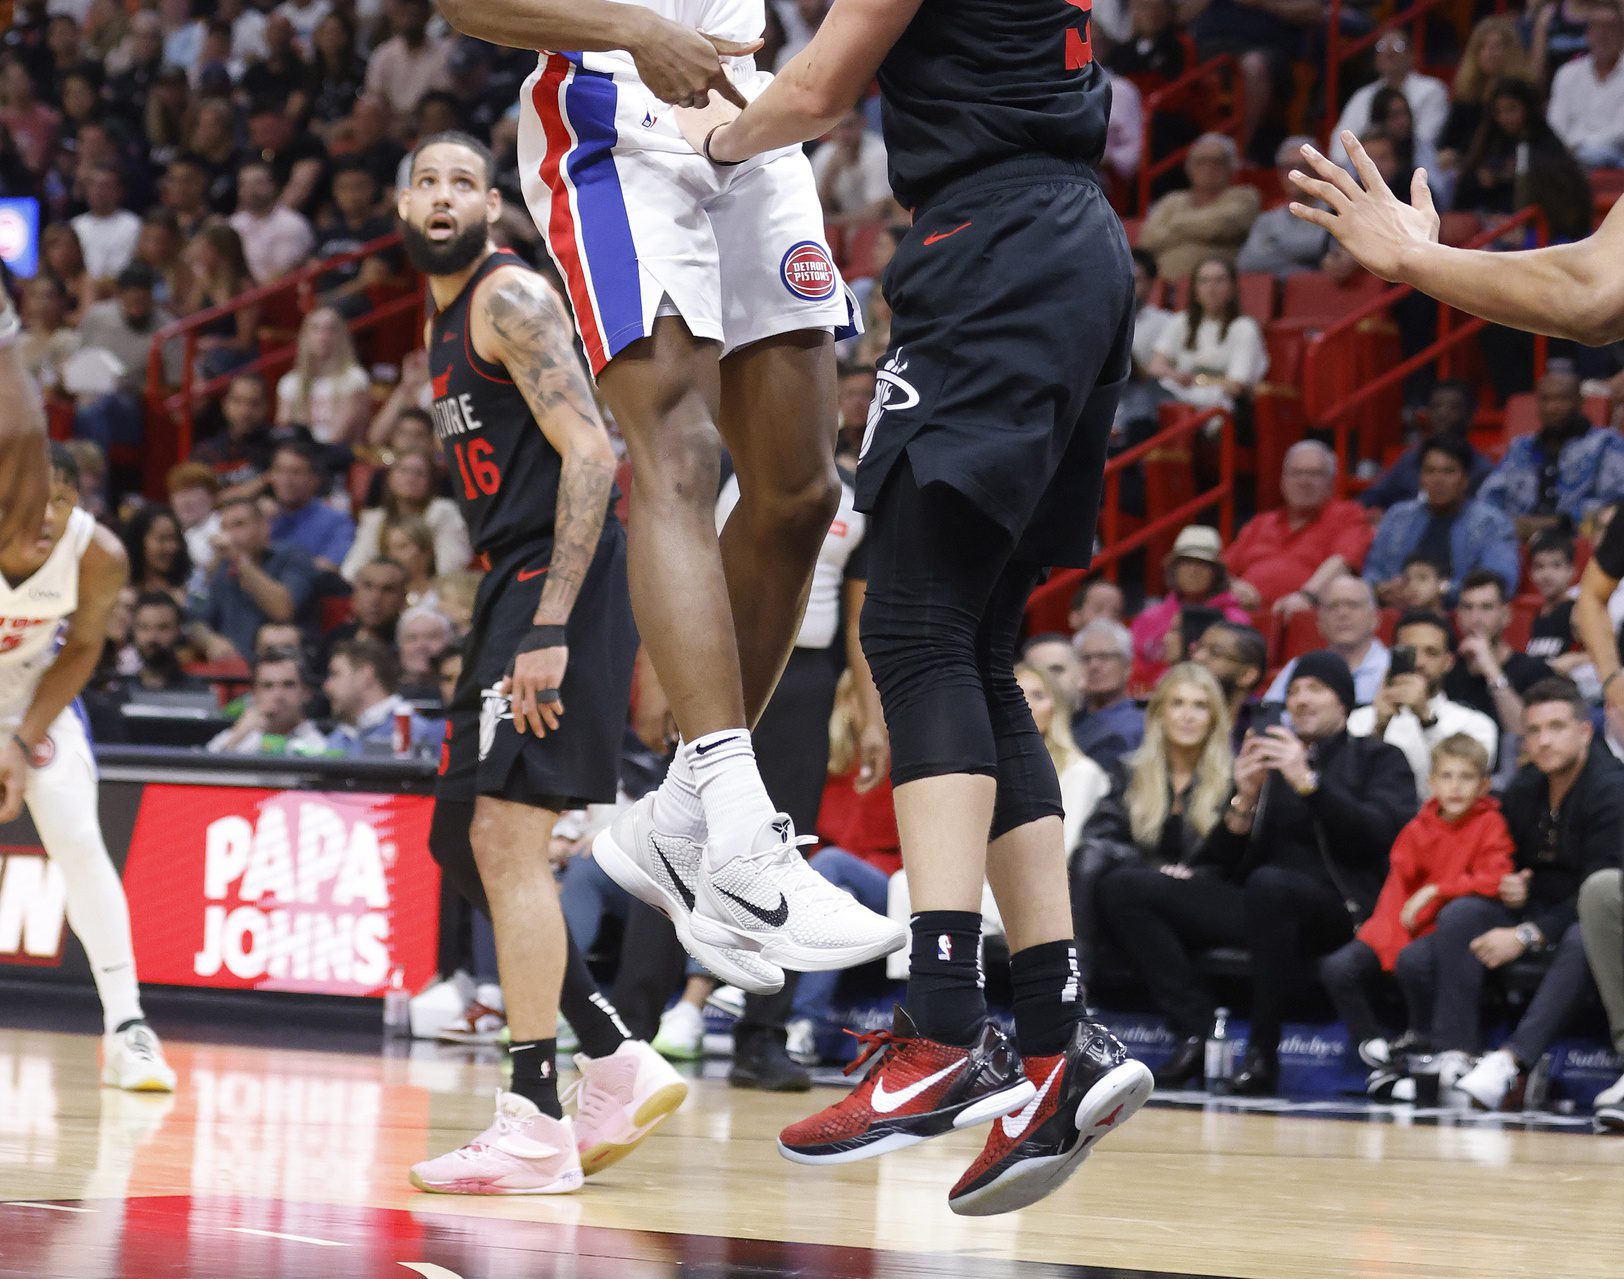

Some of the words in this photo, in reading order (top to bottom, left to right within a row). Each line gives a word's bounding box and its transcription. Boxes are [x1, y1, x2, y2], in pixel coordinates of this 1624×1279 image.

[792, 261, 827, 272] DETROIT
[794, 271, 830, 281] PISTONS
[454, 437, 501, 500] 16
[204, 802, 390, 908] PAPA
[194, 904, 390, 986] JOHNS
